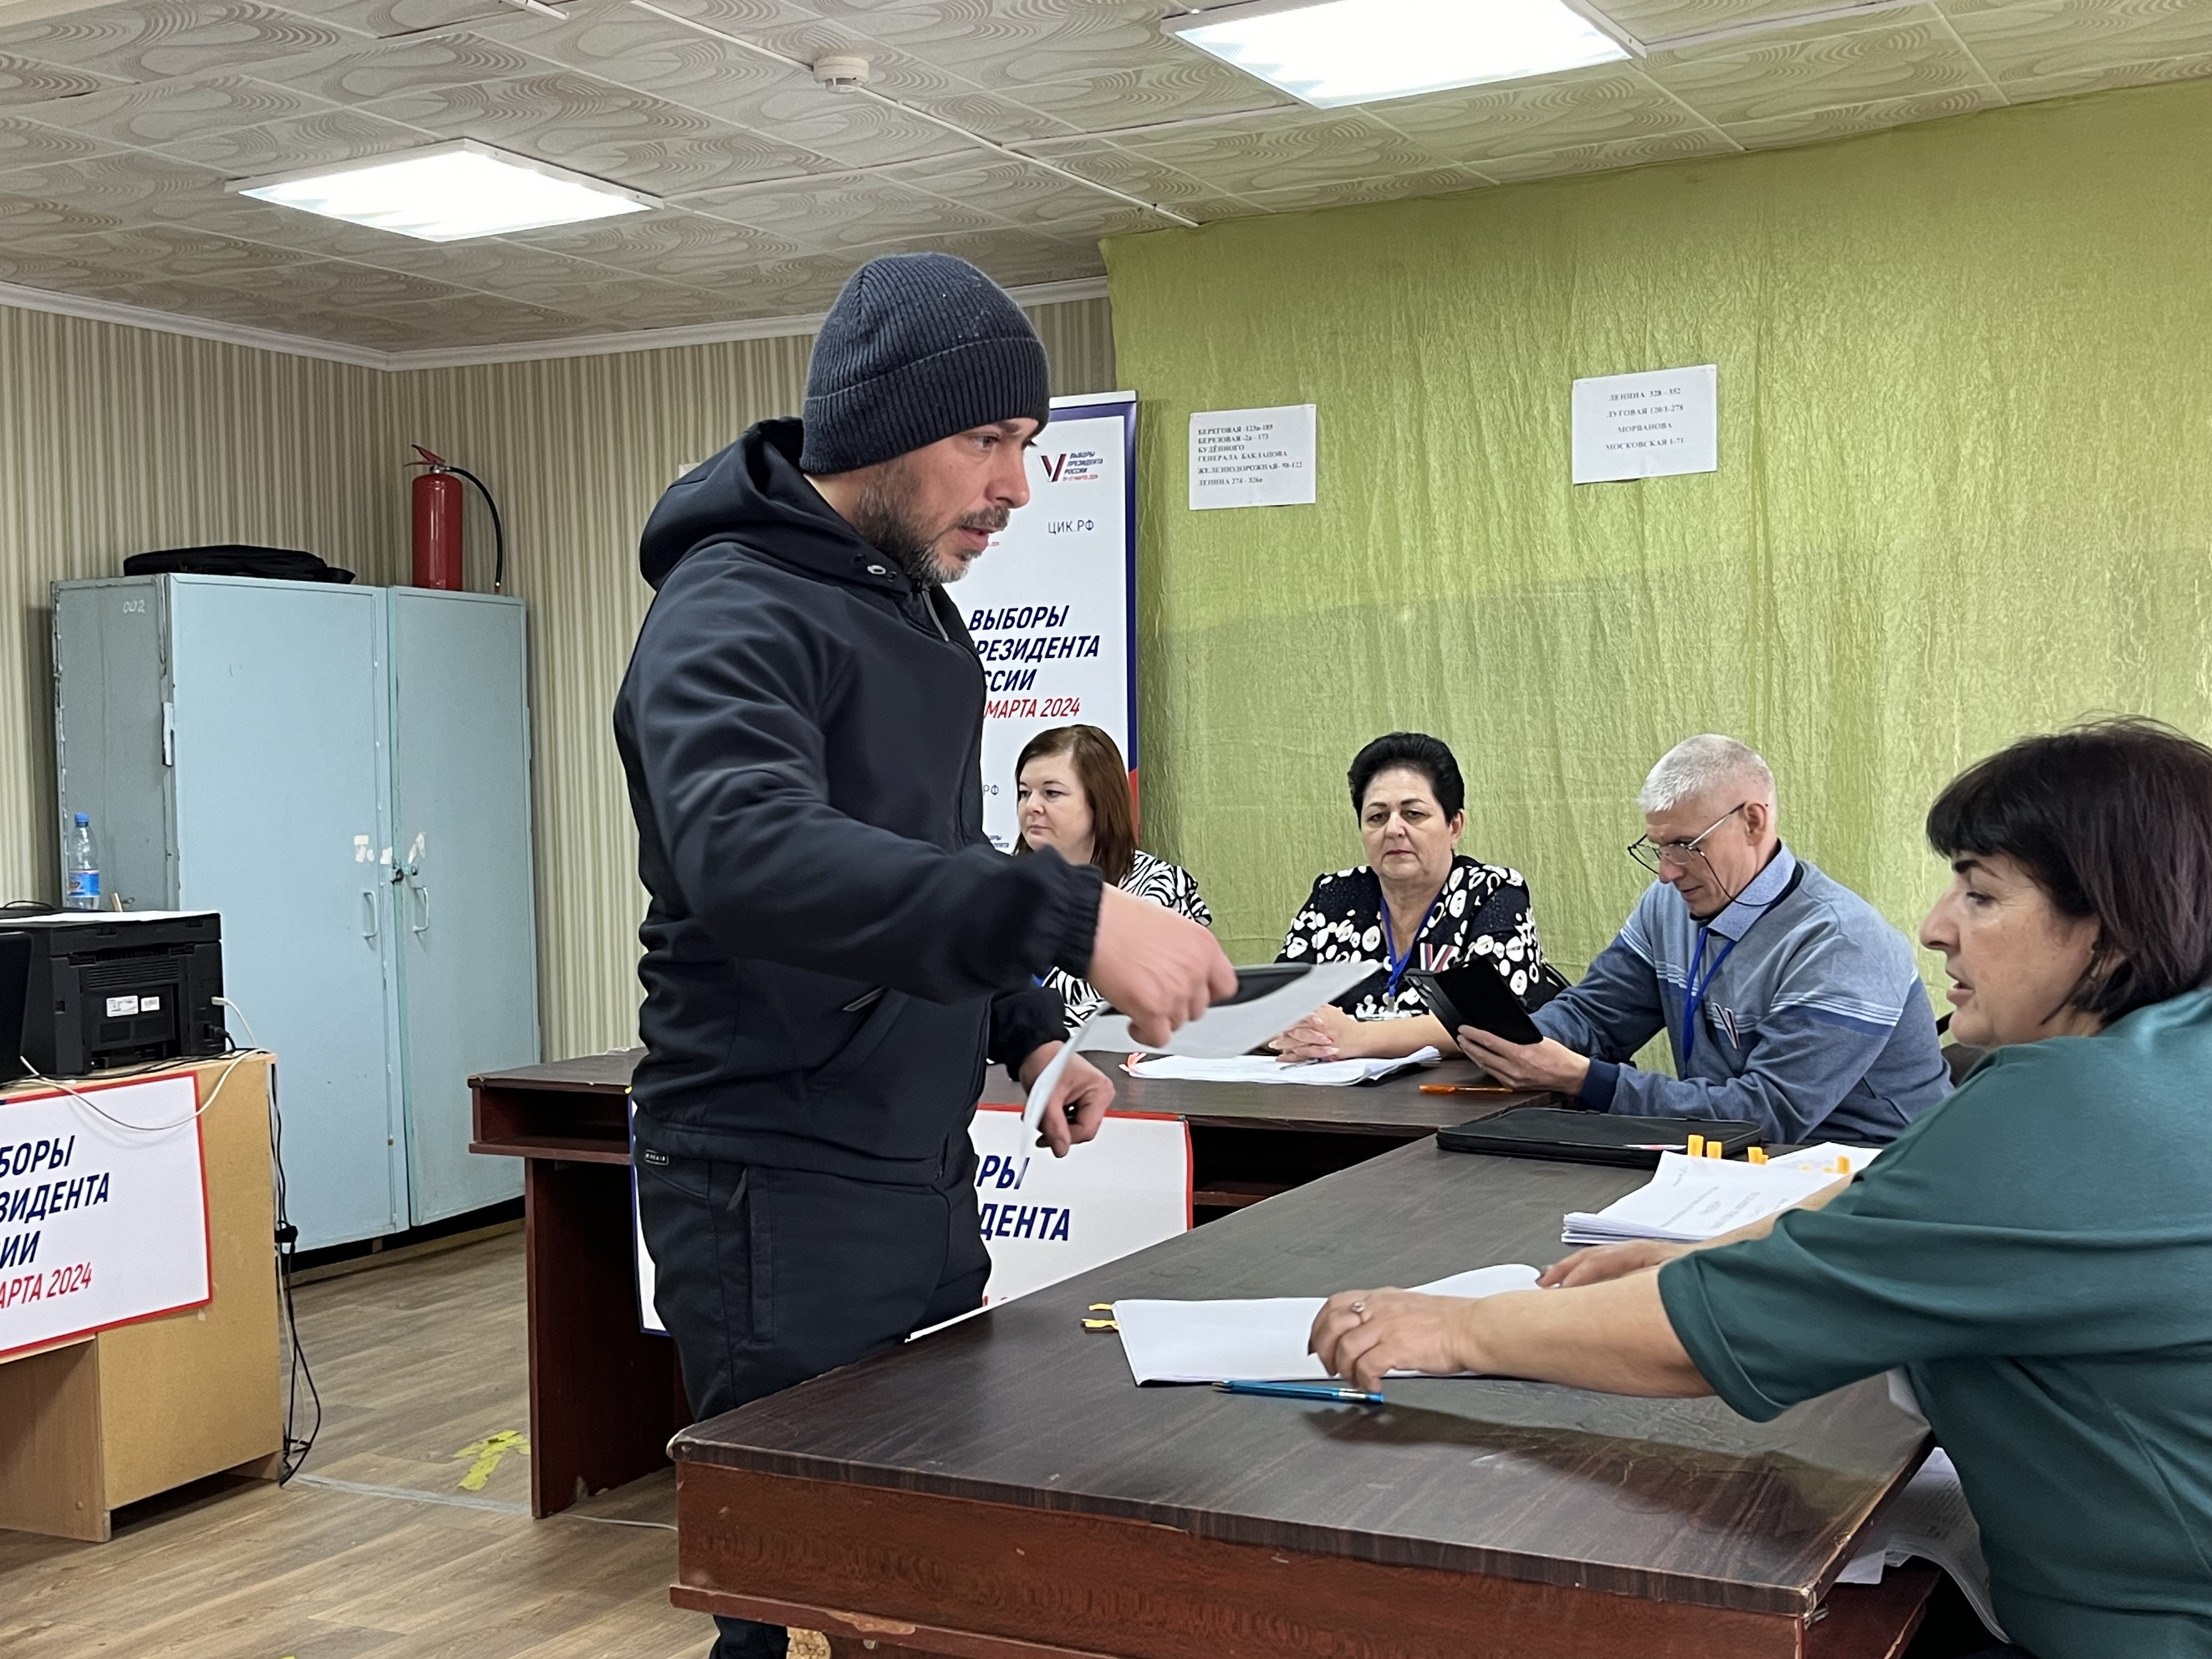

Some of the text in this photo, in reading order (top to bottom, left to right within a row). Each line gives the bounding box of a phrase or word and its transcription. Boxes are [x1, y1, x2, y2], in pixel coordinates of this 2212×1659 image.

[1198, 426, 1242, 435] БЕРЕГОВАЯ
[1605, 438, 1667, 450] МОСКОВСКАЯ
[968, 605, 1070, 631] ВЫБОРЫ
[975, 635, 1100, 663] РЕЗИДЕНТА
[984, 697, 1080, 719] МАРТА 2024
[0, 1135, 75, 1178] БОРЫ
[0, 1172, 110, 1223] ЗИДЕНТА
[978, 1203, 1070, 1242] ДЕНТА
[0, 1262, 92, 1309] АРТА 2024
